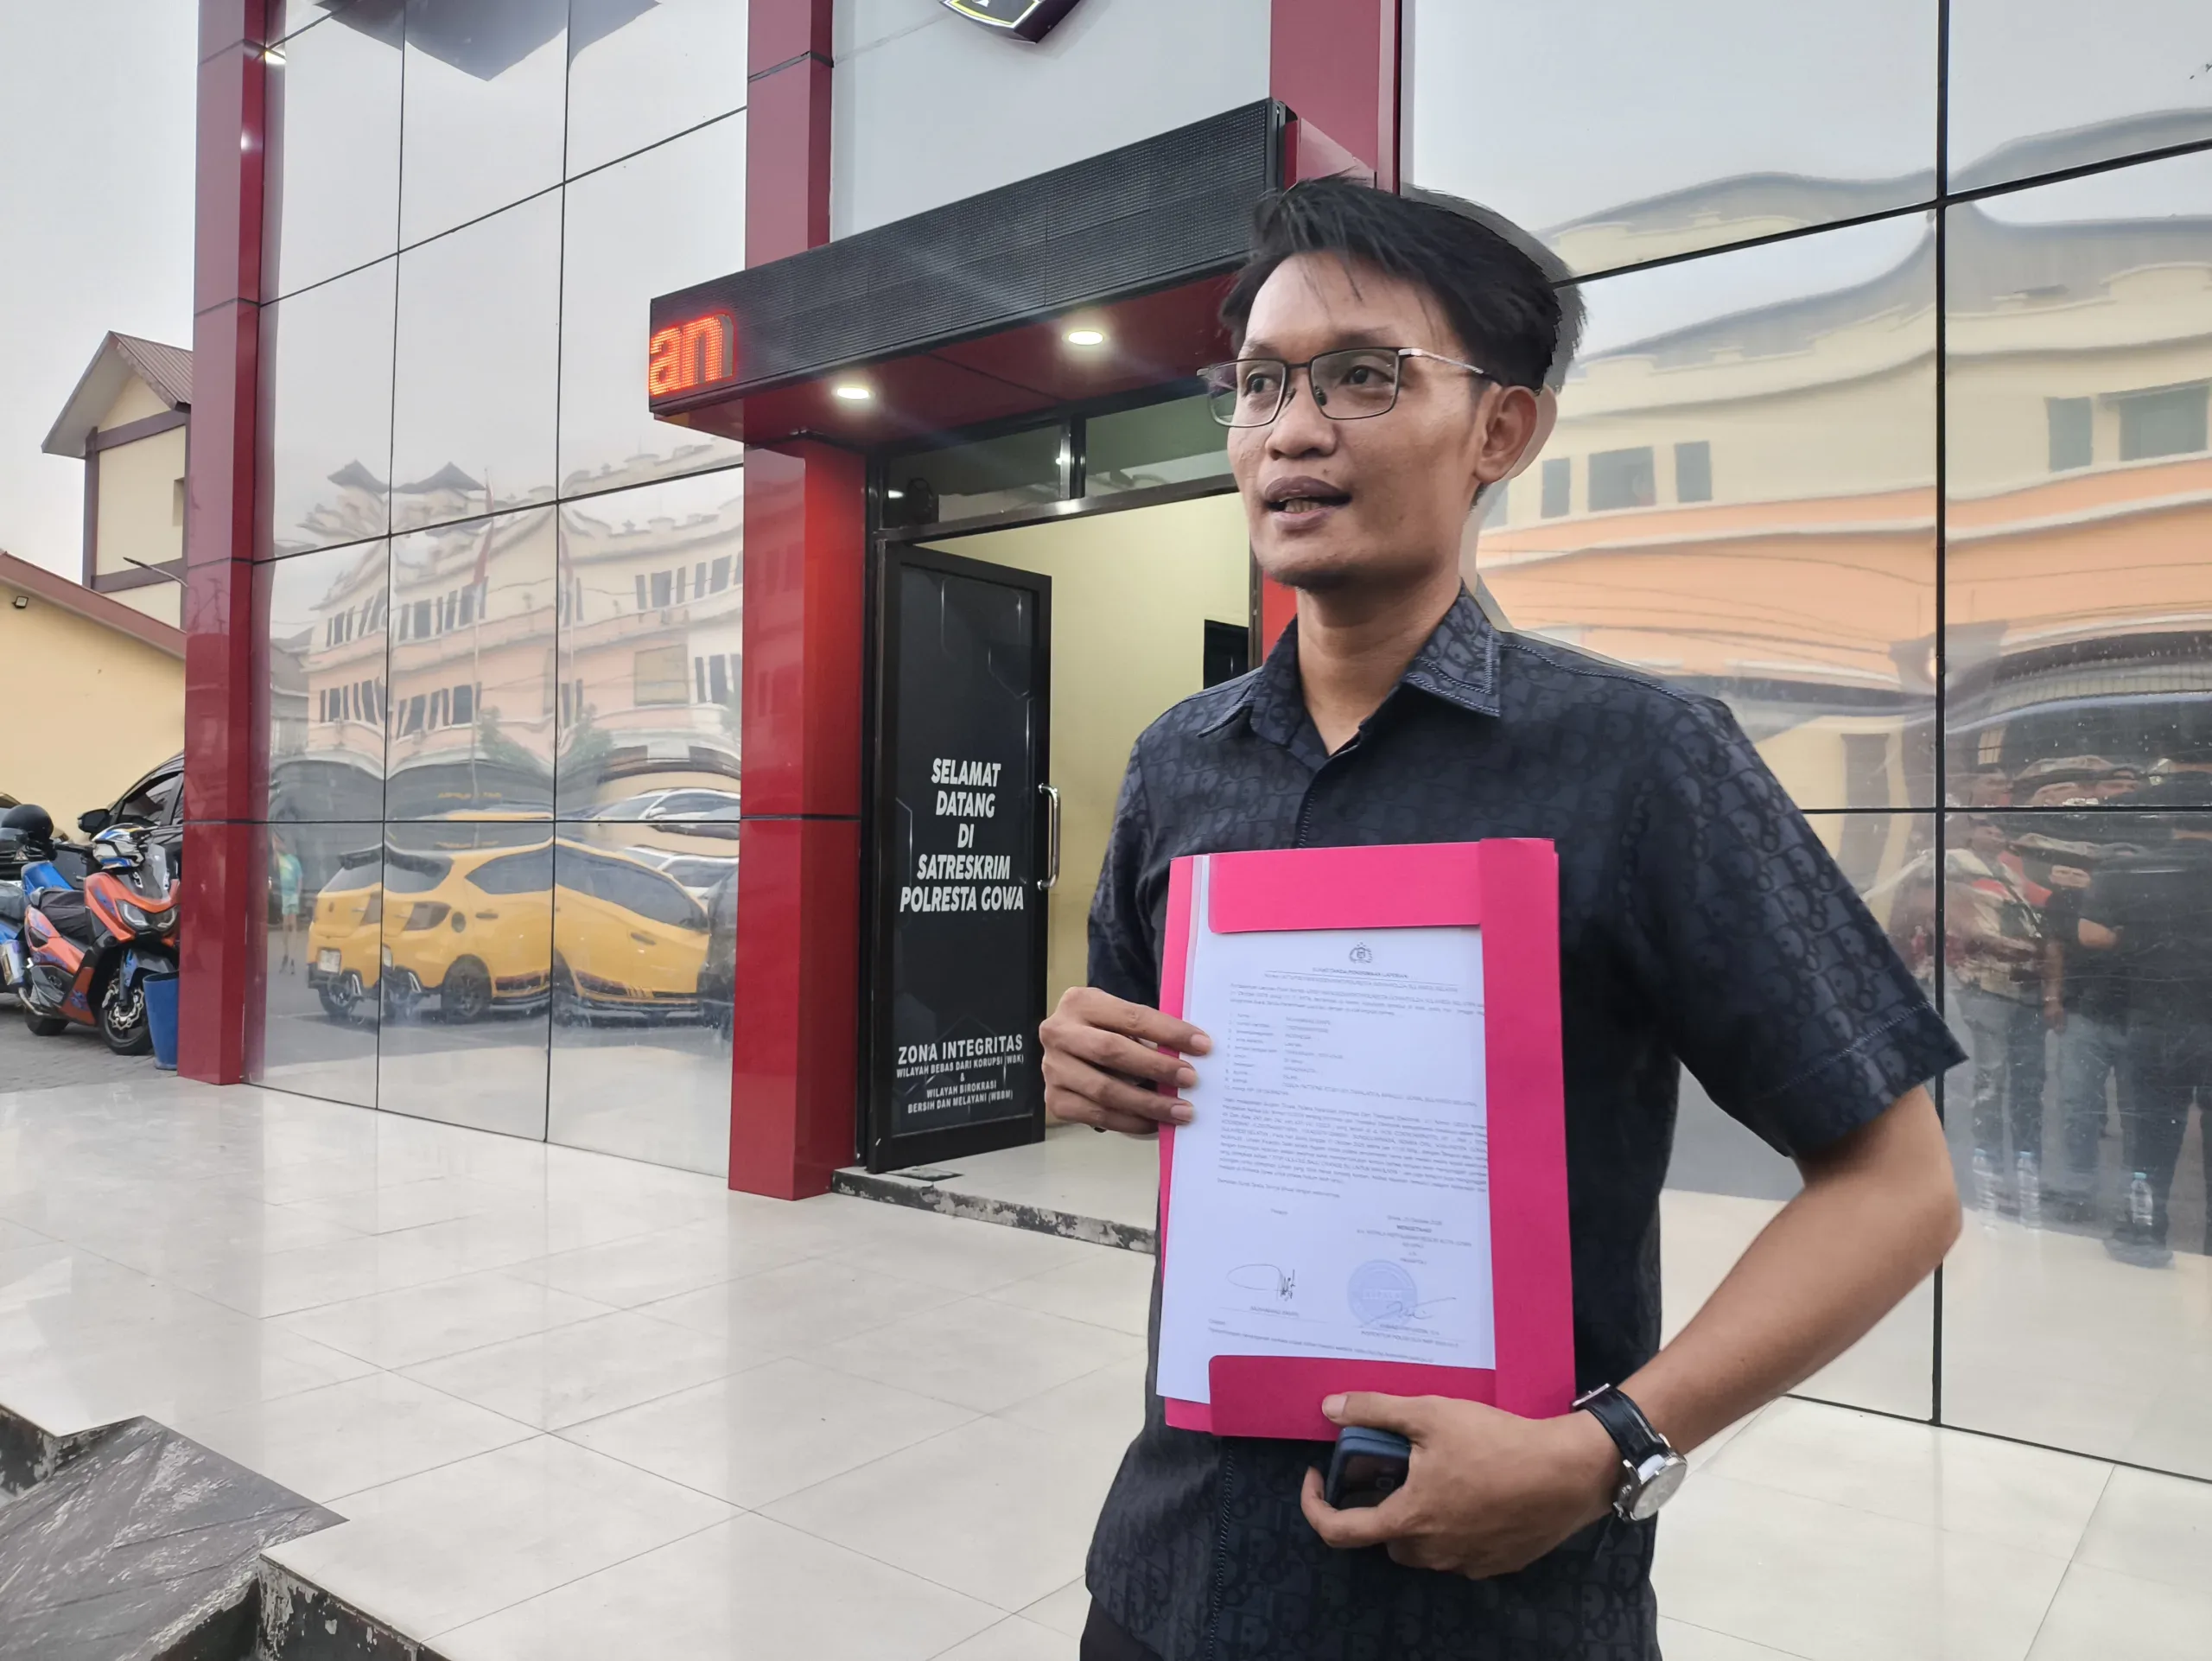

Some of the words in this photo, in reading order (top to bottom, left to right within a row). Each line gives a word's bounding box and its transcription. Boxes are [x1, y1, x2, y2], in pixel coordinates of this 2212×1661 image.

[931, 757, 1001, 787] SELAMAT
[936, 790, 995, 818] DATANG
[957, 823, 975, 848] DI
[917, 854, 1011, 880] SATRESKRIM
[899, 886, 977, 913] POLRESTA
[981, 885, 1024, 911] GOWA
[898, 1043, 938, 1065] ZONA
[943, 1034, 1023, 1060] INTEGRITAS
[896, 1066, 929, 1079] WILAYAH
[931, 1061, 954, 1074] BEBAS
[955, 1060, 972, 1071] DARI
[973, 1056, 1002, 1068] KORUPSI
[926, 1085, 958, 1098] WILAYAH
[959, 1079, 997, 1094] BIROKRASI
[907, 1102, 935, 1114] BERSIH
[937, 1098, 950, 1110] DAN
[952, 1092, 987, 1106] MELAYANI
